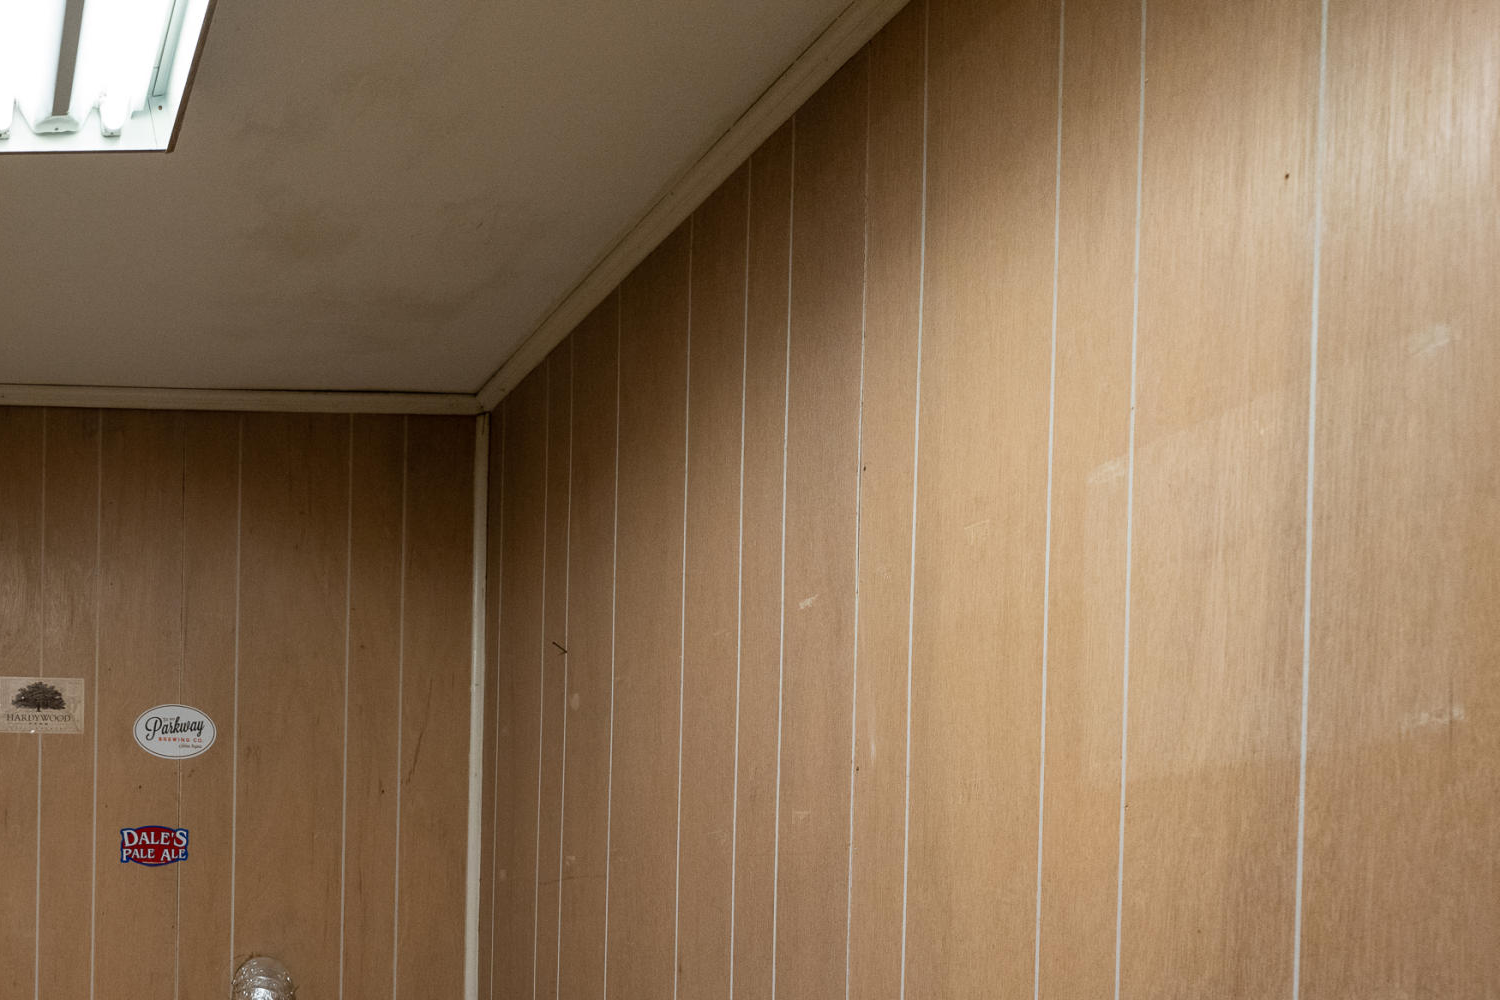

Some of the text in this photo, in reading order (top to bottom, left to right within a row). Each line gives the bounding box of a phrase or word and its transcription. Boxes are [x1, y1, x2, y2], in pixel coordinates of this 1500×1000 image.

[6, 713, 71, 722] HARDYWOOD
[145, 716, 204, 741] Parkway
[122, 829, 187, 847] DALE'S
[123, 848, 187, 861] PALE ALE
